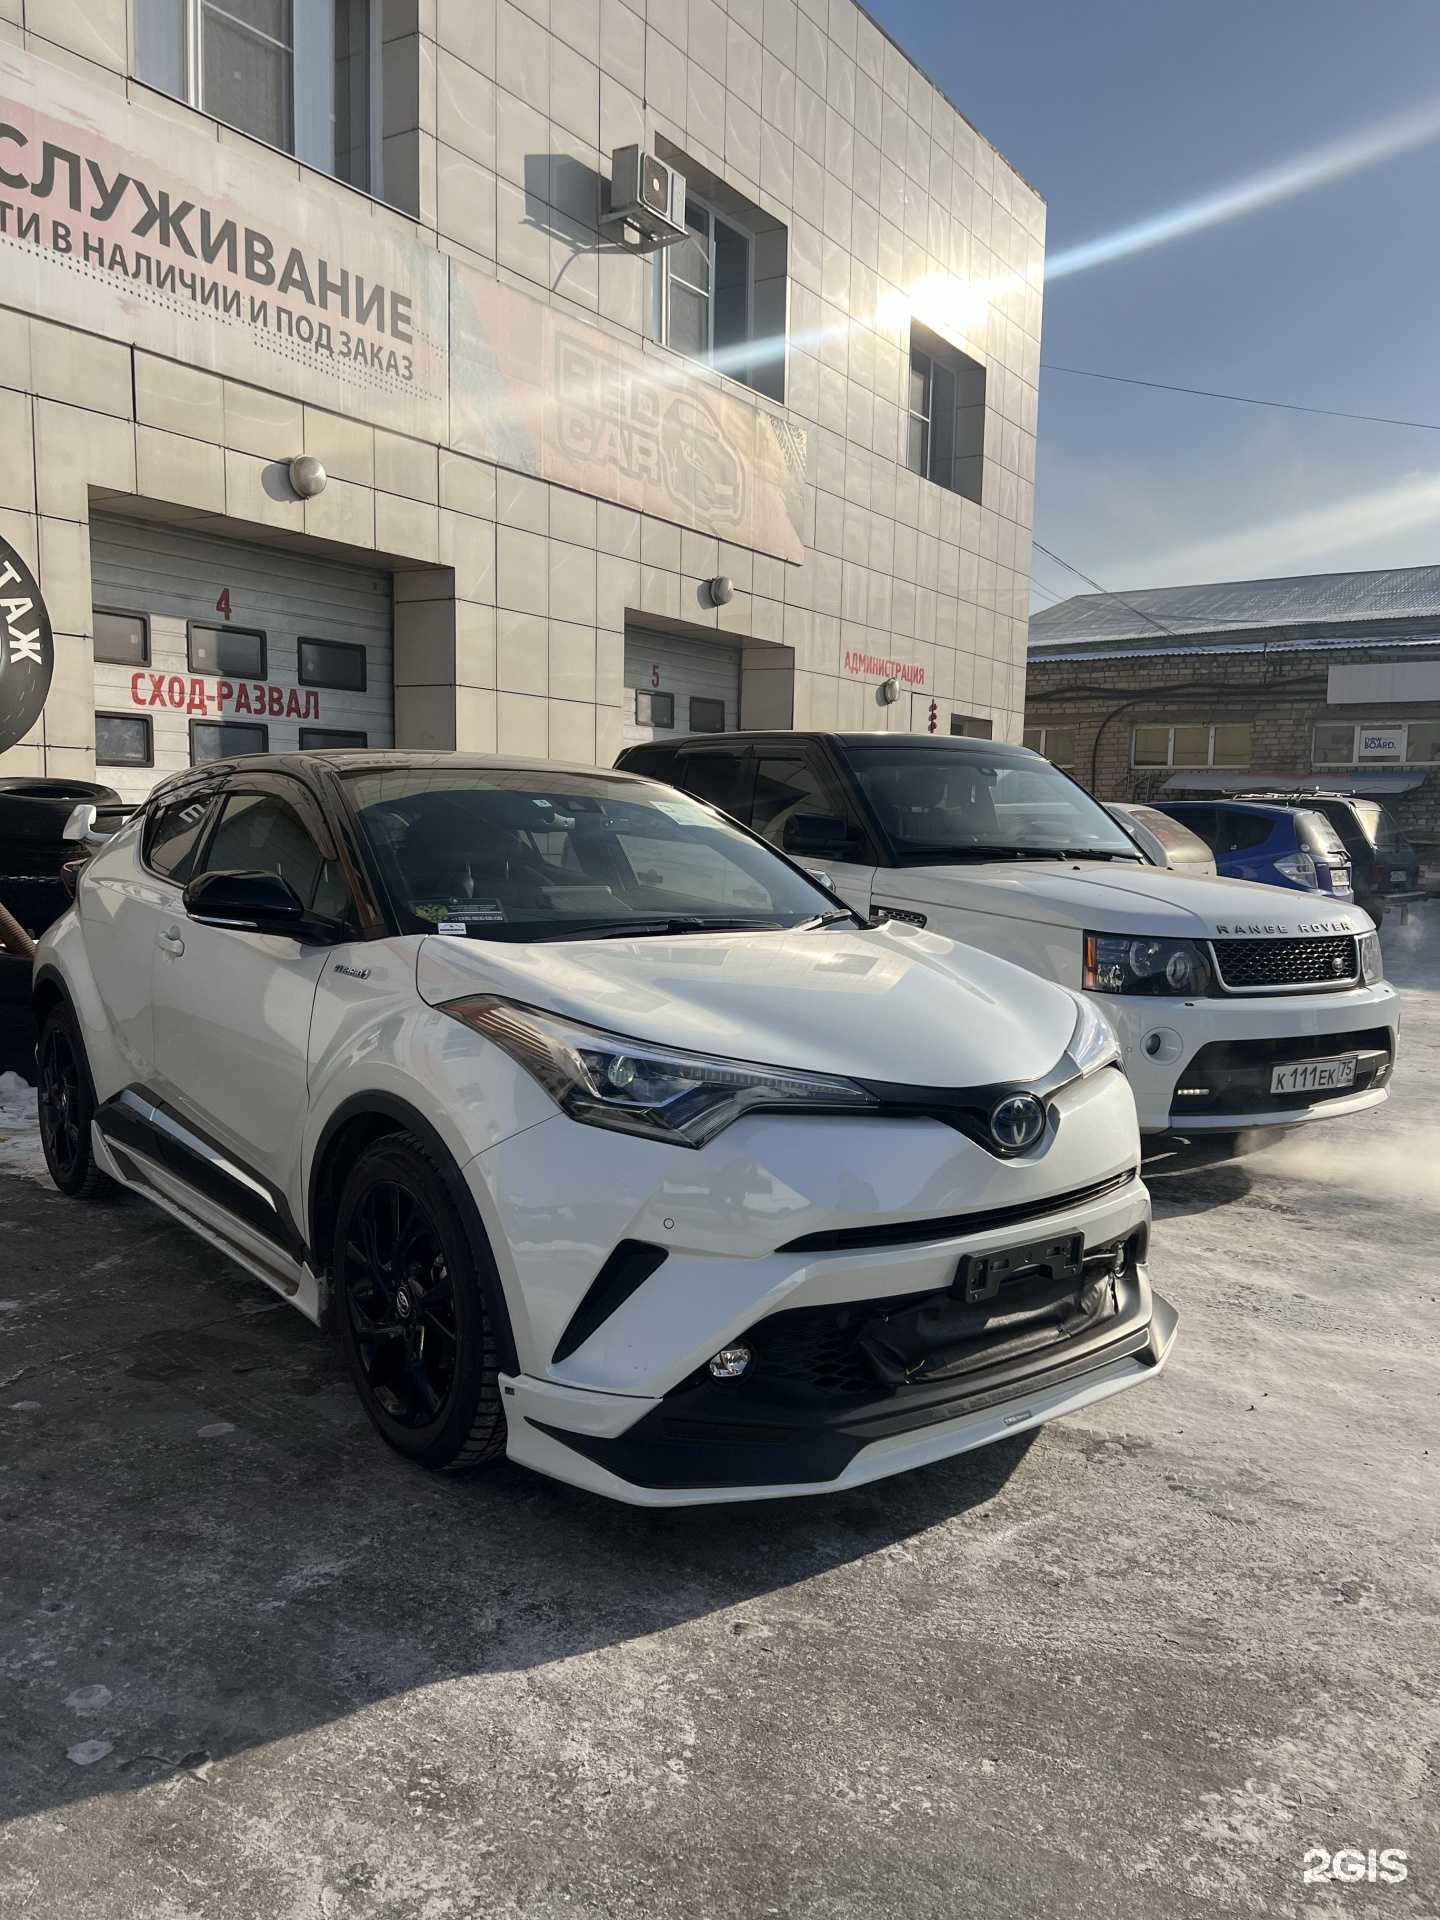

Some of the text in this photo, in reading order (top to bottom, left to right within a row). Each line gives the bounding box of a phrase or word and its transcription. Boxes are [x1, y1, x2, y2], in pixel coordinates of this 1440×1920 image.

[52, 220, 73, 254] В
[83, 232, 241, 318] НАЛИЧИИ
[251, 296, 268, 328] И
[277, 306, 334, 361] ПОД
[337, 331, 414, 382] ЗАКАЗ
[561, 408, 662, 484] CAR
[215, 587, 232, 621] 4
[651, 664, 660, 688] 5
[844, 651, 925, 685] АДМИНИСТРАЦИЯ
[130, 672, 320, 720] СХОД-РАЗВАЛ
[1215, 922, 1350, 935] RANGE ROVER
[1340, 1060, 1353, 1078] 75
